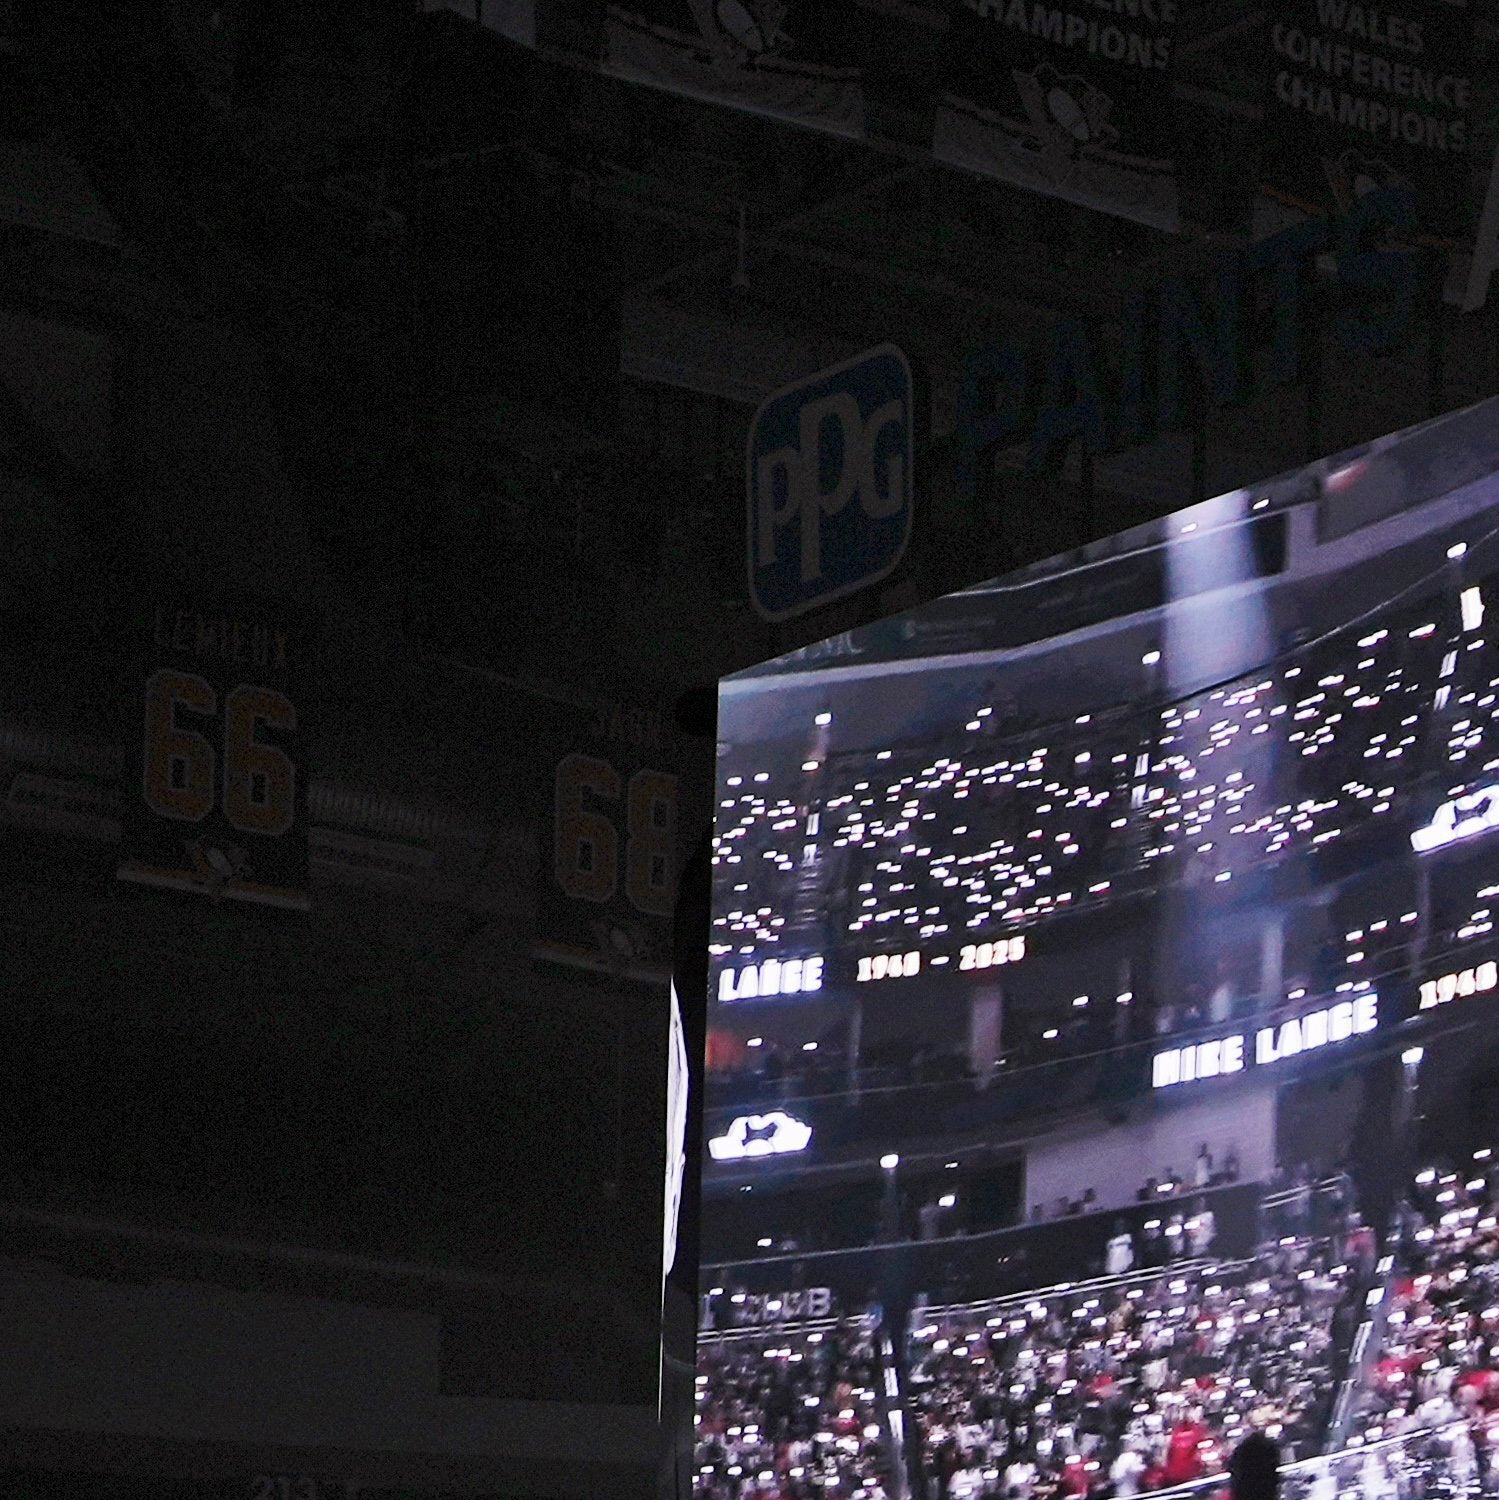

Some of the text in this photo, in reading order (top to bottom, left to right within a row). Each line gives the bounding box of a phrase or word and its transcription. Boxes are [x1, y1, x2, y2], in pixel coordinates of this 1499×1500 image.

[1272, 22, 1471, 109] CONFERENCE
[1275, 70, 1466, 152] CHAMPIONS
[142, 667, 299, 838] 66
[553, 753, 679, 917] 68
